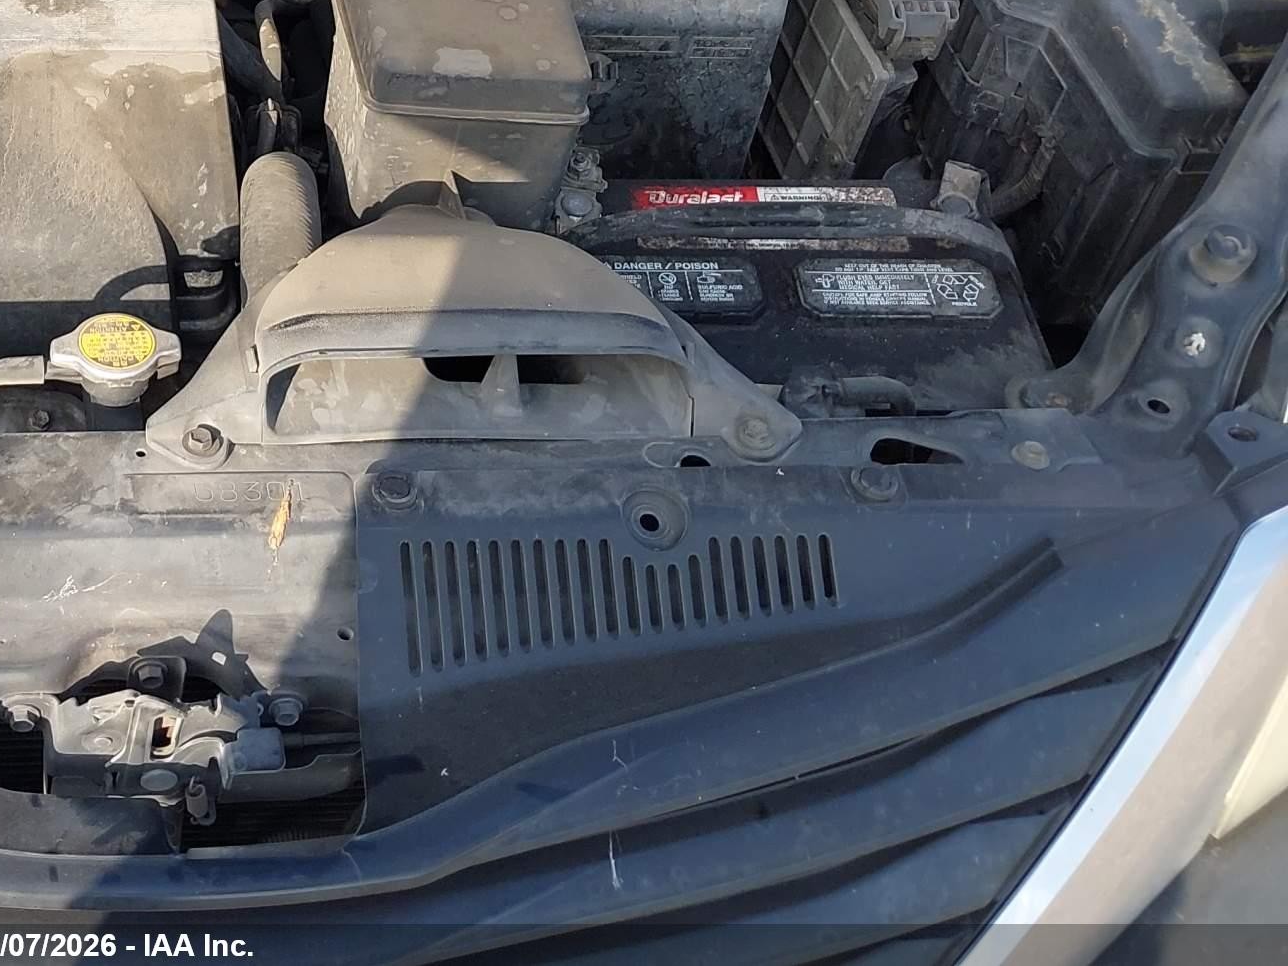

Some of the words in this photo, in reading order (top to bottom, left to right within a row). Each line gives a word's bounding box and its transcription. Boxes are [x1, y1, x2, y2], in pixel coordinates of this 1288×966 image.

[644, 191, 744, 205] Duralast
[614, 262, 663, 270] DANGER
[675, 262, 719, 270] POISON
